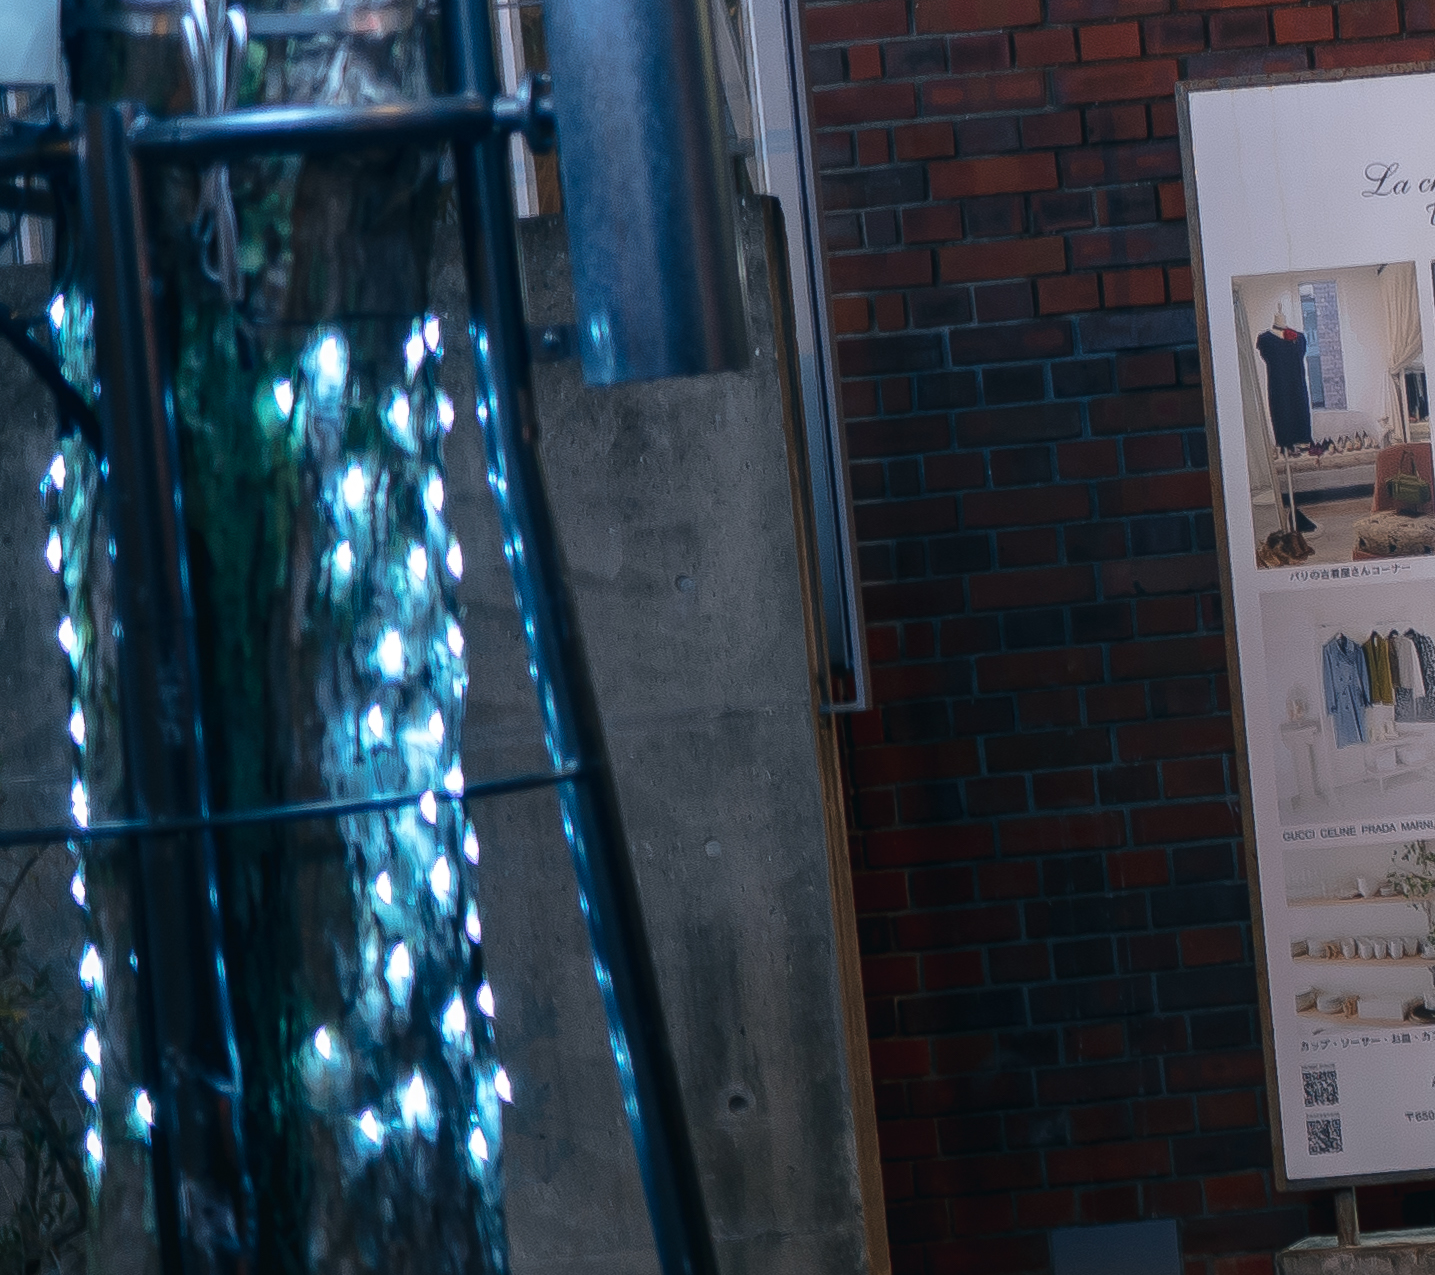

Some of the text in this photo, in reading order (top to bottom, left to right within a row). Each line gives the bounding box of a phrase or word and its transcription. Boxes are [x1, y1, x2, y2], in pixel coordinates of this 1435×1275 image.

[1361, 162, 1411, 198] La
[1289, 563, 1411, 582] パリの古着屋さんコーナー
[1282, 828, 1316, 842] GUCCI
[1320, 826, 1357, 839] CELINE
[1361, 822, 1397, 835] PRADA
